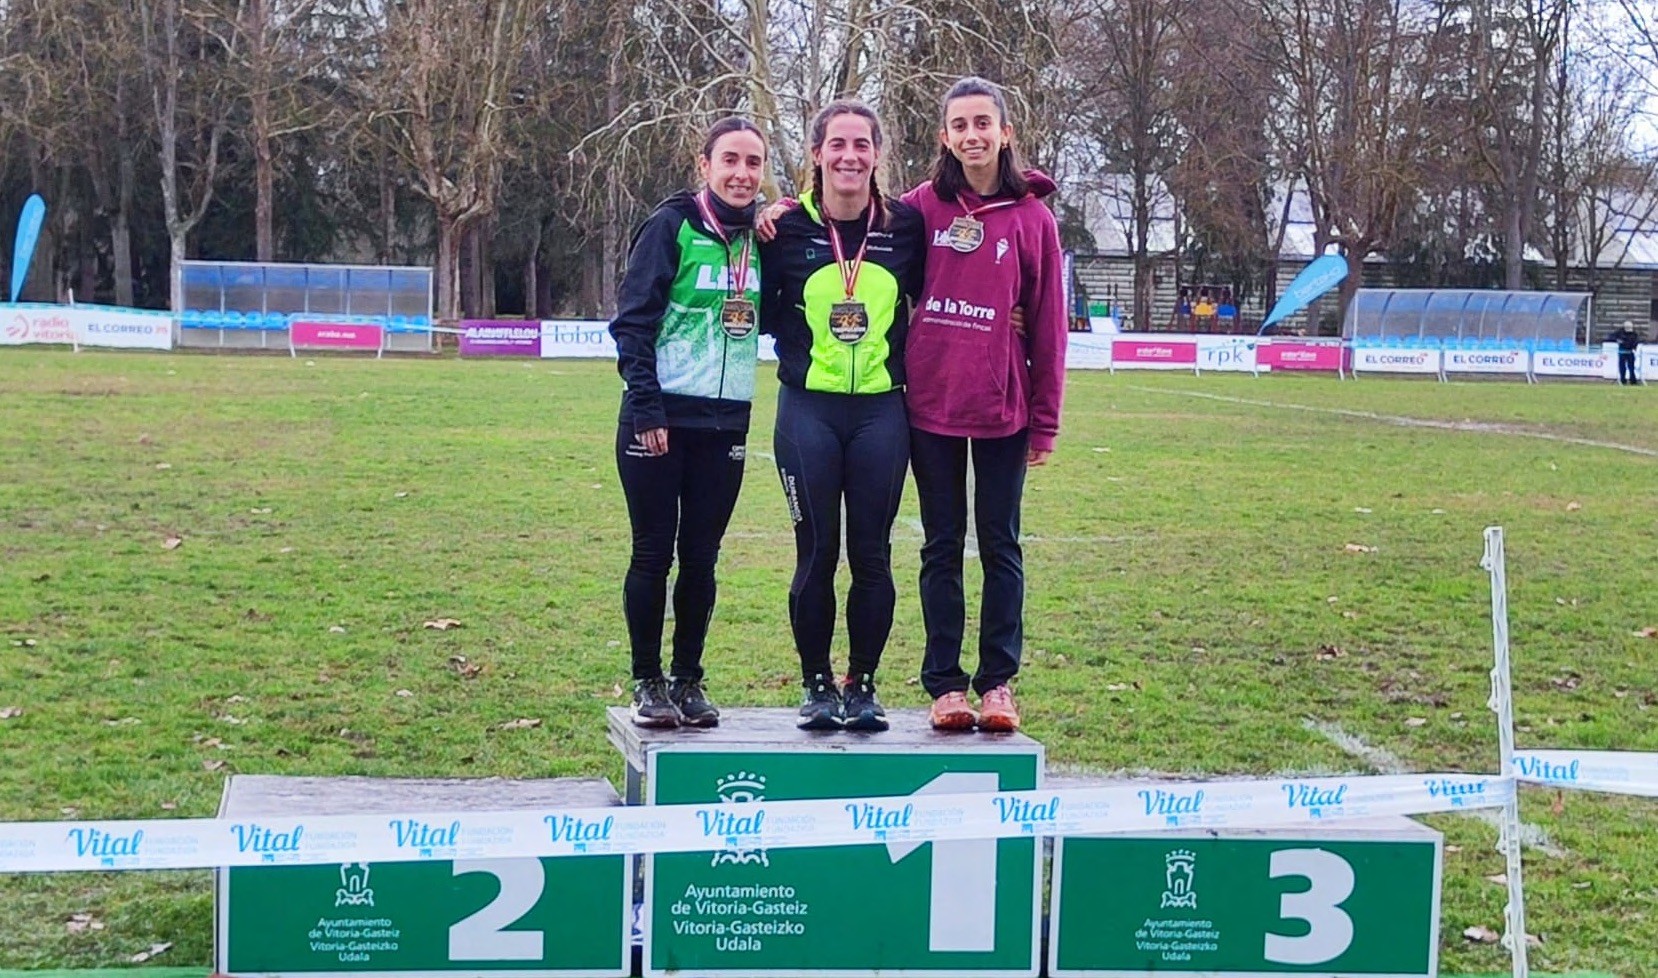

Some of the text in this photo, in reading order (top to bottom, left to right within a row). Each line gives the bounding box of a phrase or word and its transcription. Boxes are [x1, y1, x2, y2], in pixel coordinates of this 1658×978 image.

[925, 296, 996, 320] de la Torre
[87, 323, 101, 333] EL
[103, 323, 153, 335] CORREO
[1207, 348, 1244, 366] rpk
[1365, 355, 1424, 365] EL CORREO
[1453, 354, 1515, 365] EL CORREO
[1542, 357, 1604, 368] EL CORREO
[1511, 756, 1580, 780] Vital
[1137, 789, 1205, 815] Vital
[1281, 782, 1348, 808] Vital
[845, 802, 913, 830] Vital
[992, 796, 1060, 823] Vital
[543, 814, 614, 842] Vital
[696, 809, 765, 836] Vital
[230, 823, 304, 852] Vital
[388, 819, 461, 847] Vital
[66, 828, 144, 857] Vital
[885, 772, 999, 952] 1
[684, 883, 795, 901] Ayuntamiento
[448, 857, 545, 961] 2
[671, 900, 808, 915] de Vitoria-Gasteiz
[1264, 848, 1355, 965] 3
[318, 917, 392, 929] Ayuntamiento
[673, 920, 805, 935] Vitoria-Gasteizko
[1144, 918, 1212, 929] Ayuntamiento
[308, 928, 400, 938] de Vitoria-Gasteiz
[1135, 928, 1220, 939] de Vitoria-Gasteiz
[310, 941, 399, 951] Vitoria-Gasteizko
[716, 936, 762, 951] Udala
[1136, 941, 1218, 951] Vitoria-Gasteizko
[339, 952, 370, 961] Udala
[1162, 951, 1191, 961] Udala
